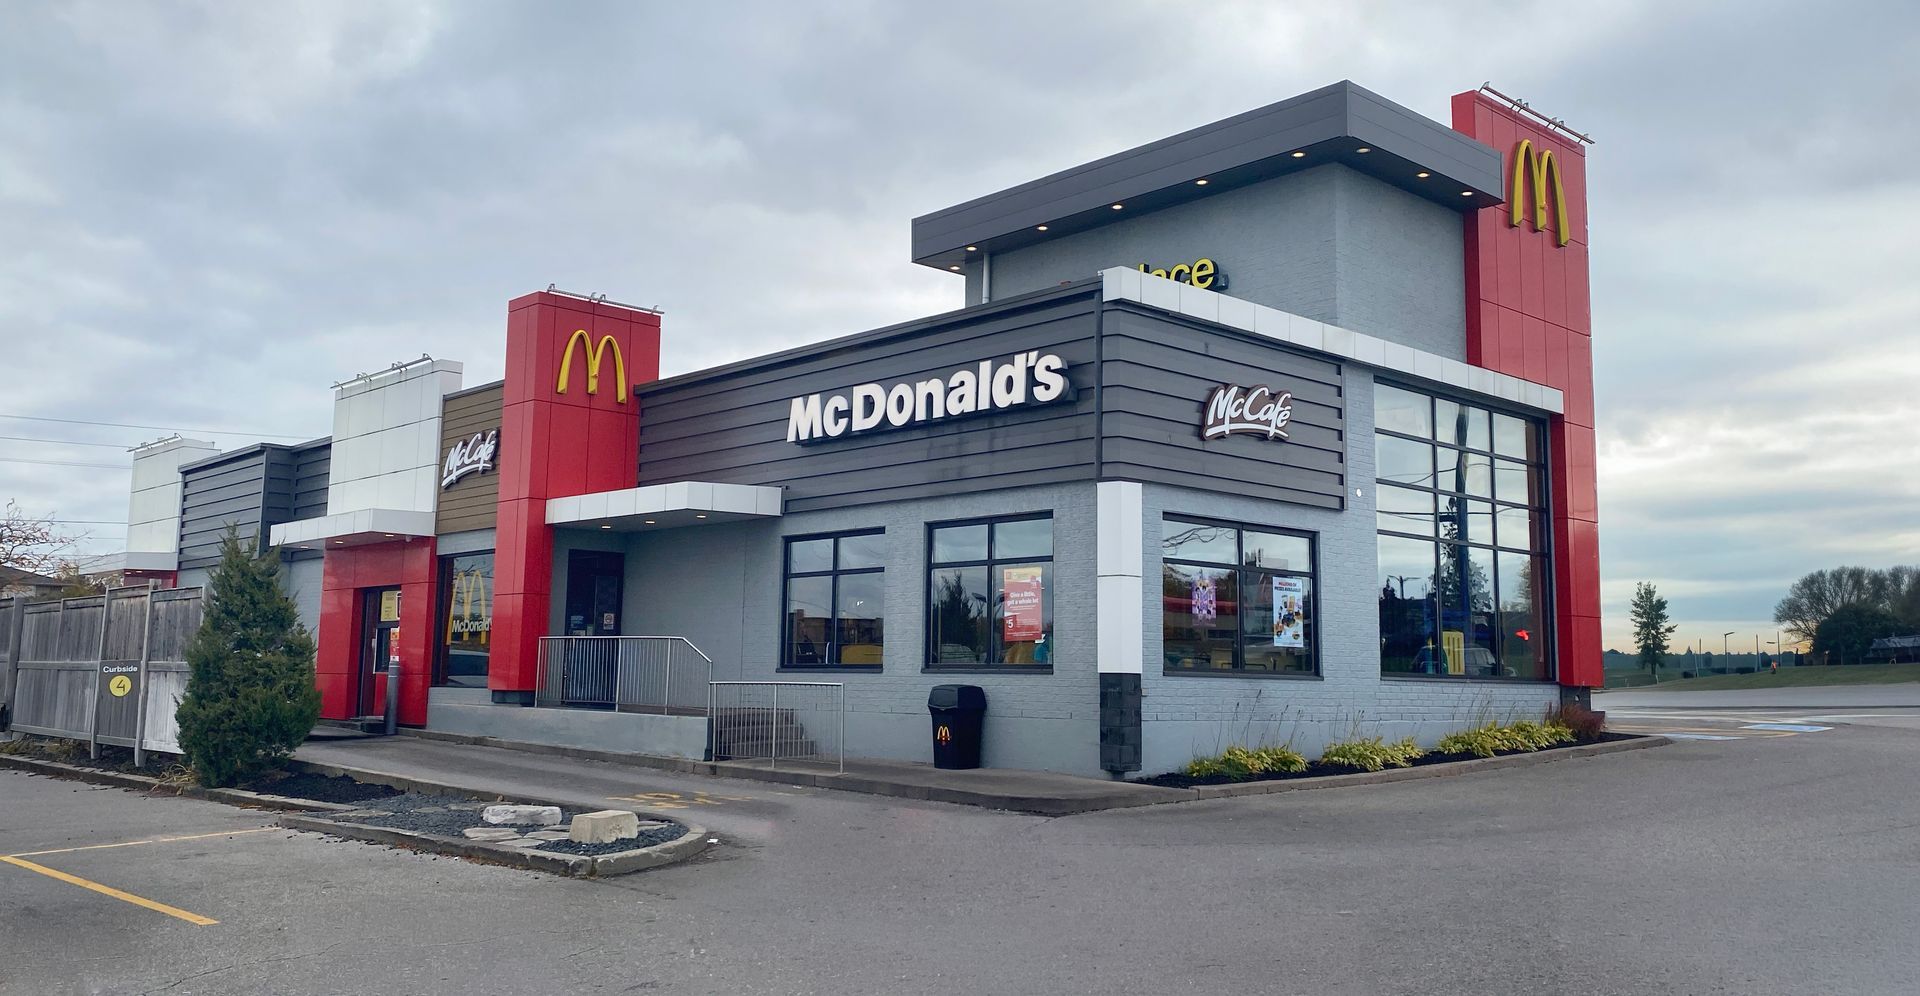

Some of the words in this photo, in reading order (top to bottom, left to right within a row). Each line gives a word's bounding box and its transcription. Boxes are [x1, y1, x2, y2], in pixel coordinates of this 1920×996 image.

[786, 350, 1066, 442] McDonald's
[1205, 384, 1292, 437] McCafé
[442, 430, 496, 486] McCafé
[103, 665, 138, 673] Curbside
[116, 679, 125, 692] 4
